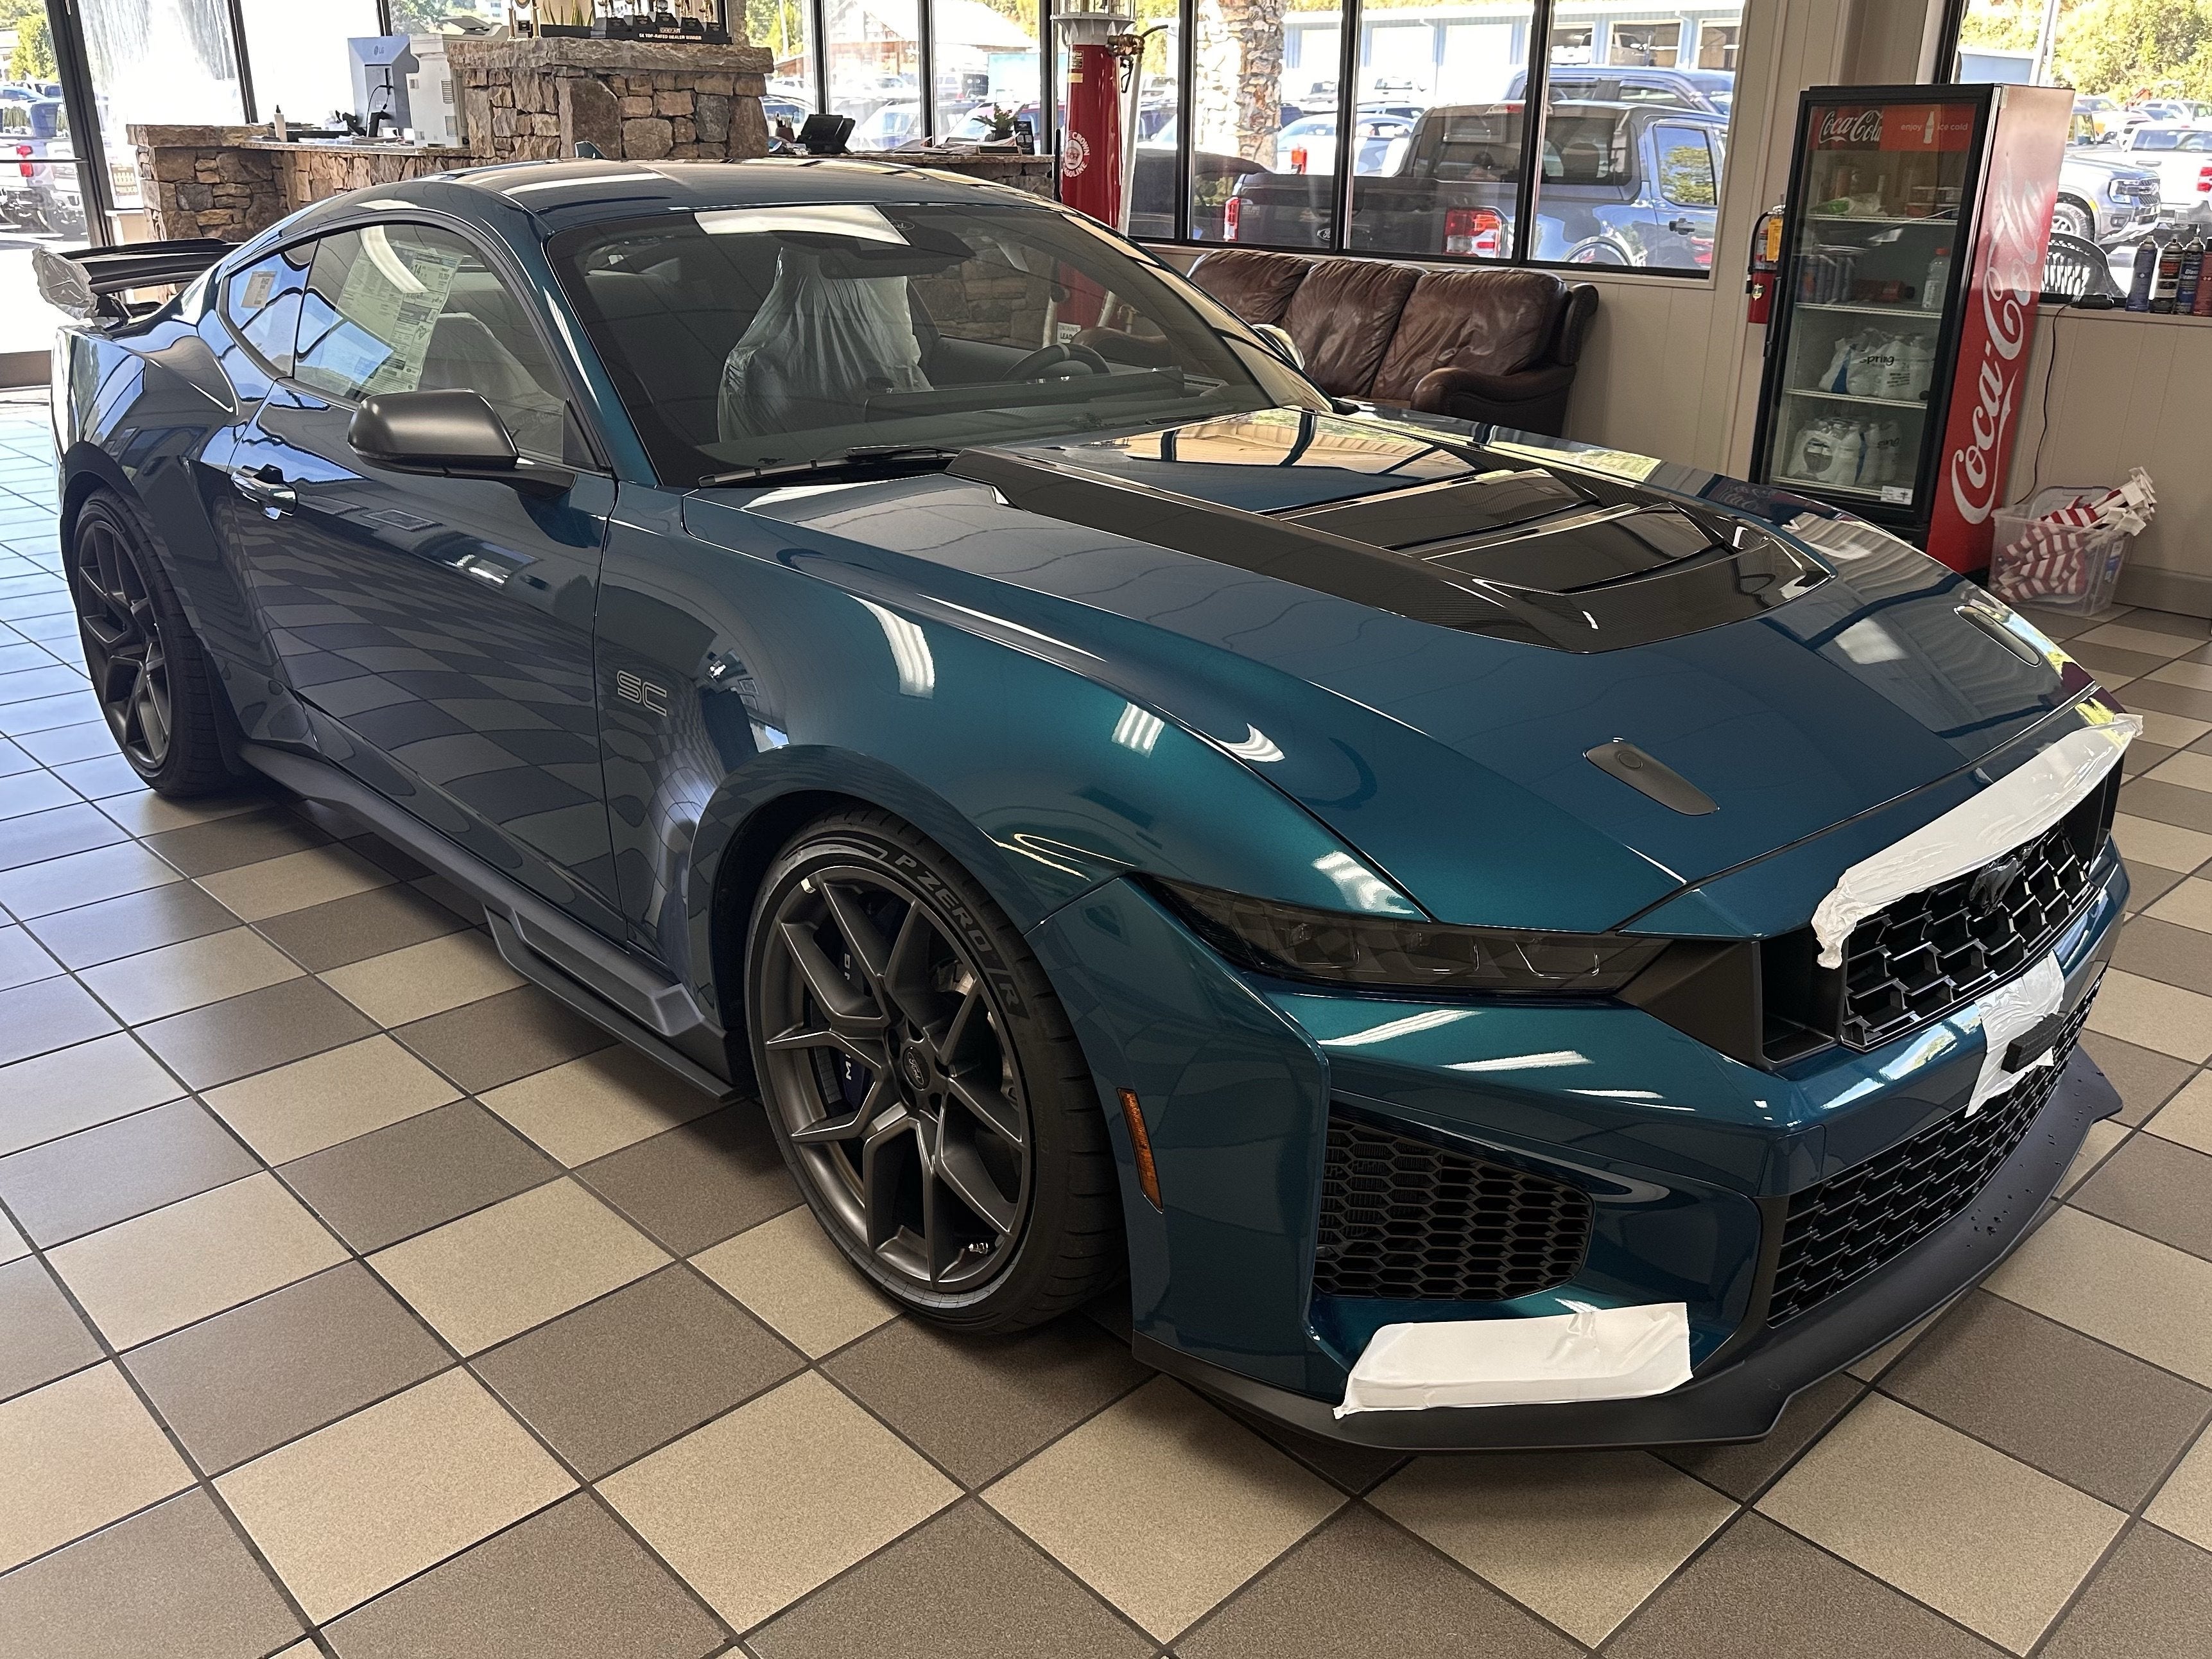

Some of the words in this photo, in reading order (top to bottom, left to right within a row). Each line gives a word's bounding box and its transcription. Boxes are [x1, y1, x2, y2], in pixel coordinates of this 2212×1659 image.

[1072, 131, 1091, 156] CROWN
[1819, 110, 1883, 144] Coca-Cola
[1900, 123, 1921, 132] enjoy
[1949, 122, 1968, 131] cold
[1951, 157, 2044, 524] Coca-Cola
[616, 670, 667, 717] SC
[895, 854, 917, 868] P
[917, 870, 992, 952] ZERO
[998, 982, 1019, 1007] R
